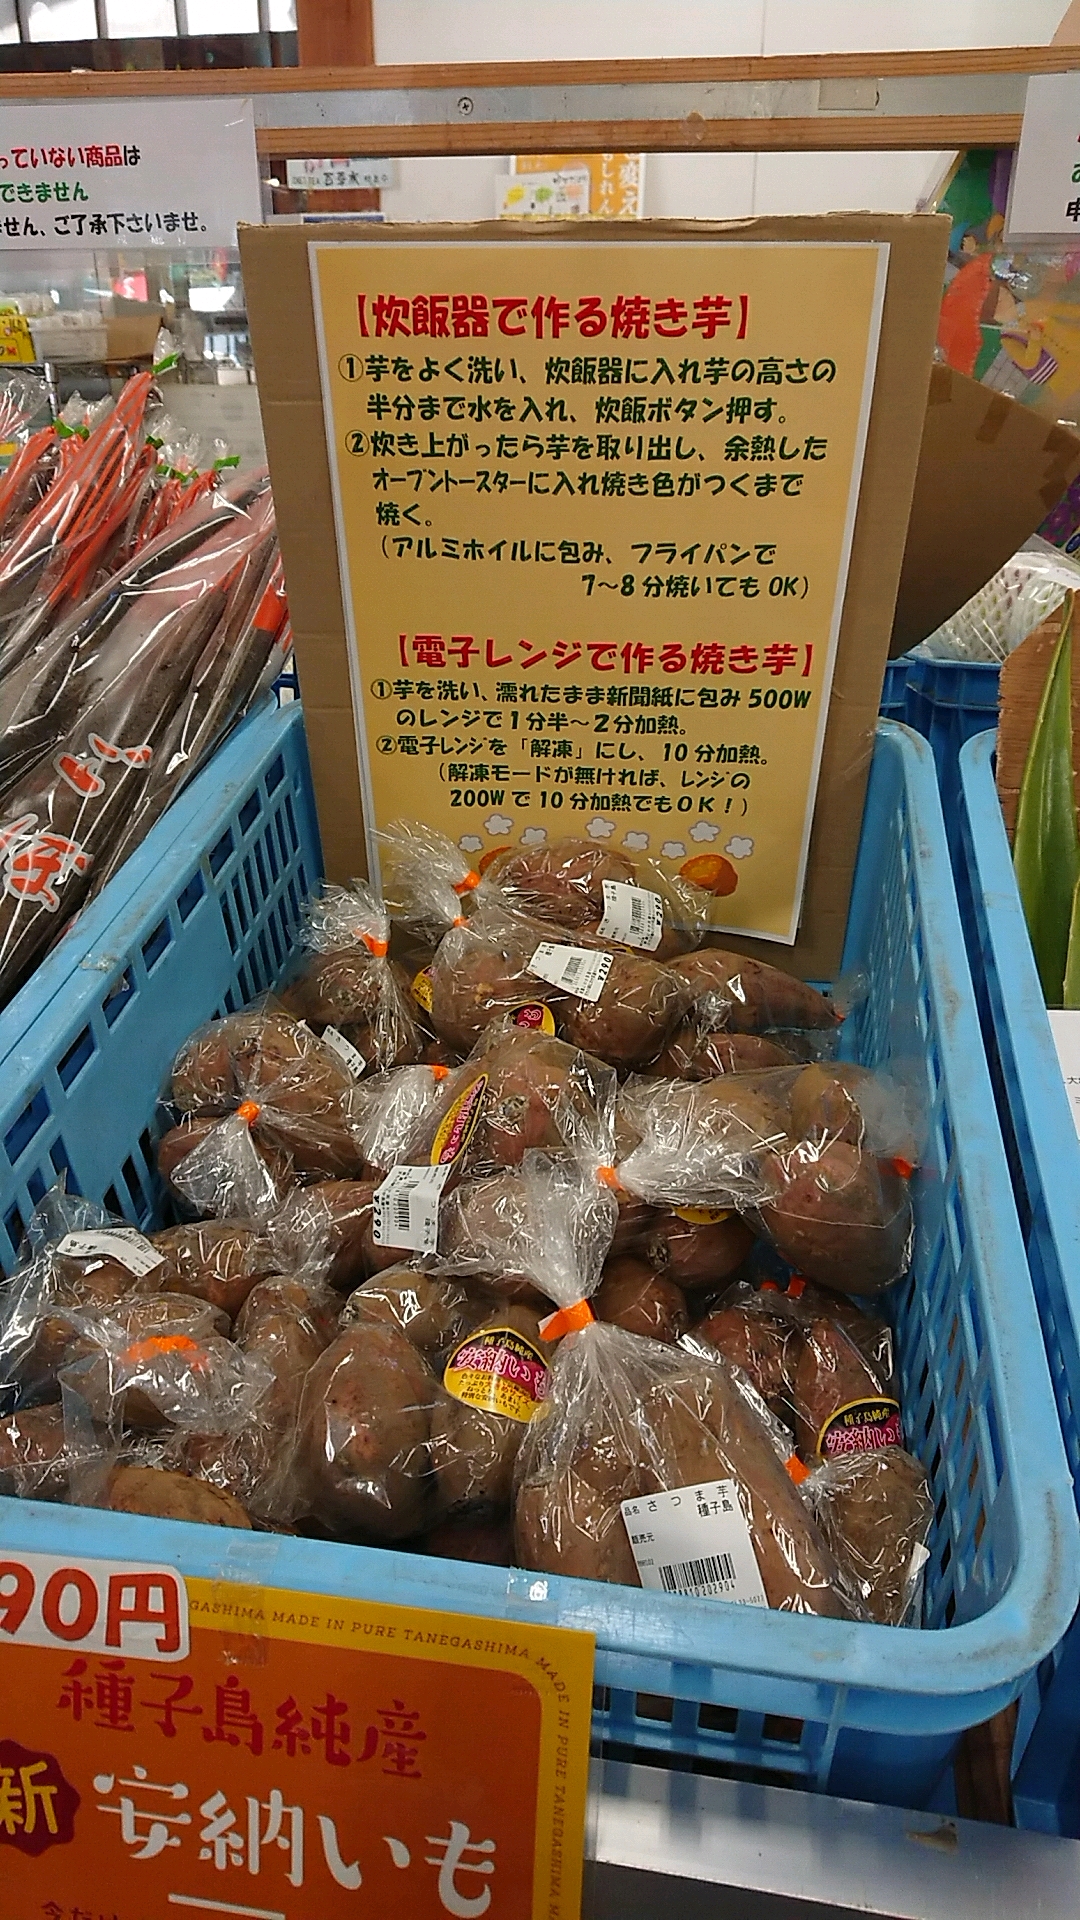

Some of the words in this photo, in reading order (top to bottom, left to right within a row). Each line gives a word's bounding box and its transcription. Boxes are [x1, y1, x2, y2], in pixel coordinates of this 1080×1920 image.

[0, 211, 207, 237] せん、ご了承下さいませ。
[697, 1499, 734, 1518] 種子島
[272, 1611, 320, 1628] MADE
[326, 1618, 346, 1631] IN
[351, 1621, 396, 1639] PURE
[404, 1629, 529, 1659] TANEGASHIMA
[56, 1658, 427, 1779] 種子島純産
[92, 1764, 498, 1919] 安納いも
